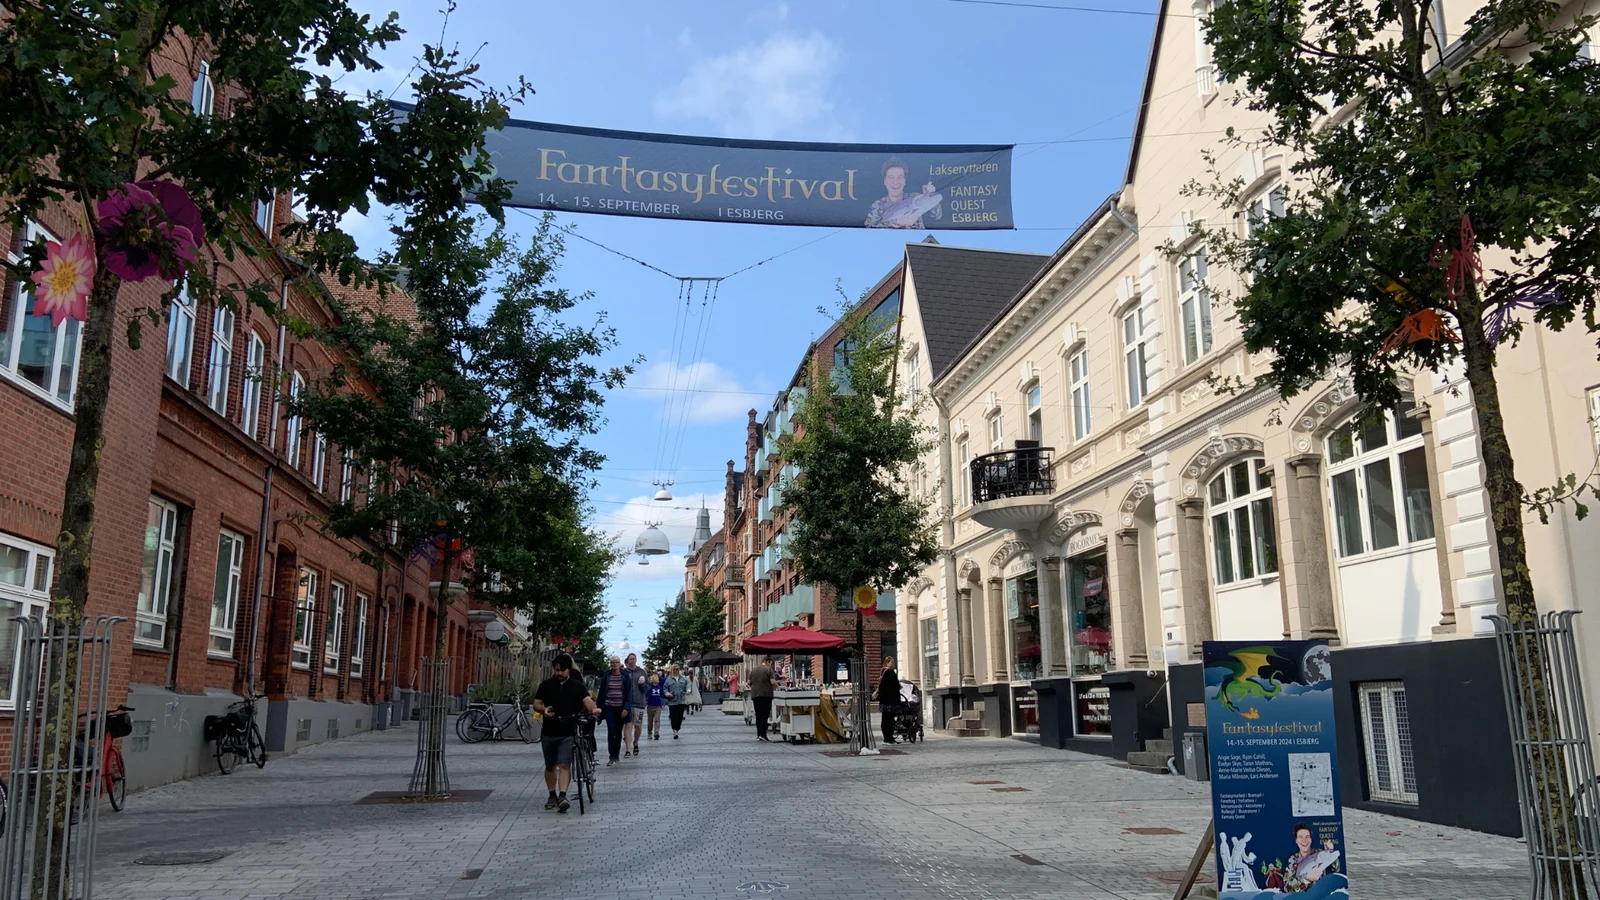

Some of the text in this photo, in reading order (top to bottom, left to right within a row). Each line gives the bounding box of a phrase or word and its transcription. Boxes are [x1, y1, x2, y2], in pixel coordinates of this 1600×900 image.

[929, 162, 998, 176] Lakserytteren
[535, 148, 858, 204] Fantasyfestival
[950, 184, 998, 197] FANTASY
[538, 192, 559, 205] 14.
[573, 195, 595, 208] 15.
[598, 198, 680, 214] SEPTEMBER
[727, 207, 784, 220] ESBJERG
[951, 199, 986, 211] QUEST
[952, 212, 998, 223] ESBJERG
[1222, 721, 1322, 736] Fantasyfestival
[1246, 738, 1278, 746] SEPTEMBER
[1278, 738, 1292, 746] 2024
[1296, 737, 1319, 745] ESBJERG
